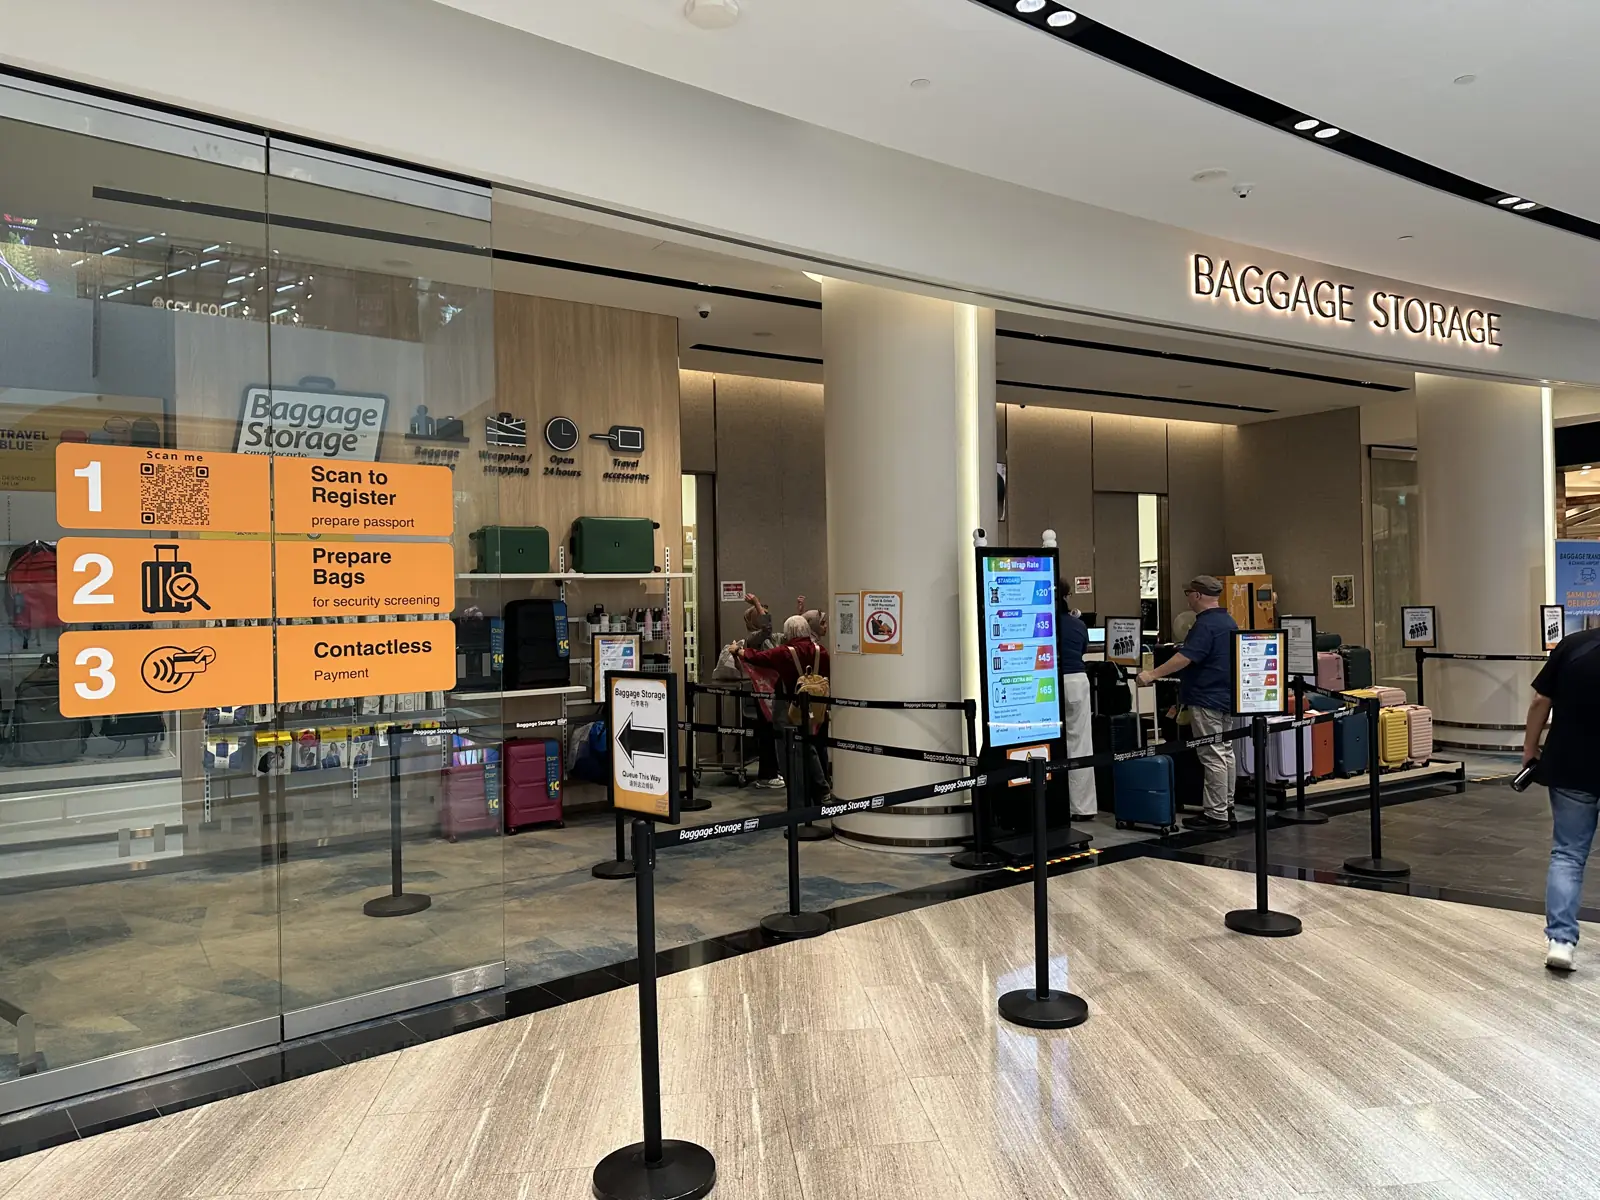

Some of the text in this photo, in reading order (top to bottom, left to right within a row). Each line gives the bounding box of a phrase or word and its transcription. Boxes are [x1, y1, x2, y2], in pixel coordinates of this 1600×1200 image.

[1193, 253, 1503, 347] BAGGAGE STORAGE
[250, 394, 378, 431] Baggage
[0, 429, 50, 441] TRAVEL
[244, 422, 359, 457] Storage
[0, 440, 33, 451] BLUE
[146, 450, 204, 461] Scan me
[478, 450, 526, 463] Wrapping
[550, 455, 575, 465] Open
[612, 458, 640, 468] Travel
[312, 466, 388, 486] Scan to
[483, 464, 530, 476] strapping
[543, 467, 582, 477] 24 hours
[603, 472, 650, 481] accessories
[74, 461, 102, 512] 1
[312, 487, 397, 509] Register
[311, 516, 415, 530] prepare passport
[312, 547, 392, 571] Prepare
[1011, 561, 1026, 569] Wrap
[72, 553, 115, 605] 2
[313, 569, 366, 590] Bags
[312, 594, 440, 610] for security screening
[313, 639, 432, 659] Contactless
[1039, 654, 1050, 662] $45
[74, 648, 116, 700] 3
[314, 667, 369, 683] Payment
[615, 688, 666, 700] Baggage Storage
[1040, 686, 1052, 694] $65
[924, 753, 965, 764] Baggage Storage
[622, 770, 638, 779] Queue
[650, 774, 661, 783] Way
[934, 777, 976, 793] Baggage Storage
[820, 799, 870, 815] Baggage Storage
[680, 821, 742, 841] Baggage Storage
